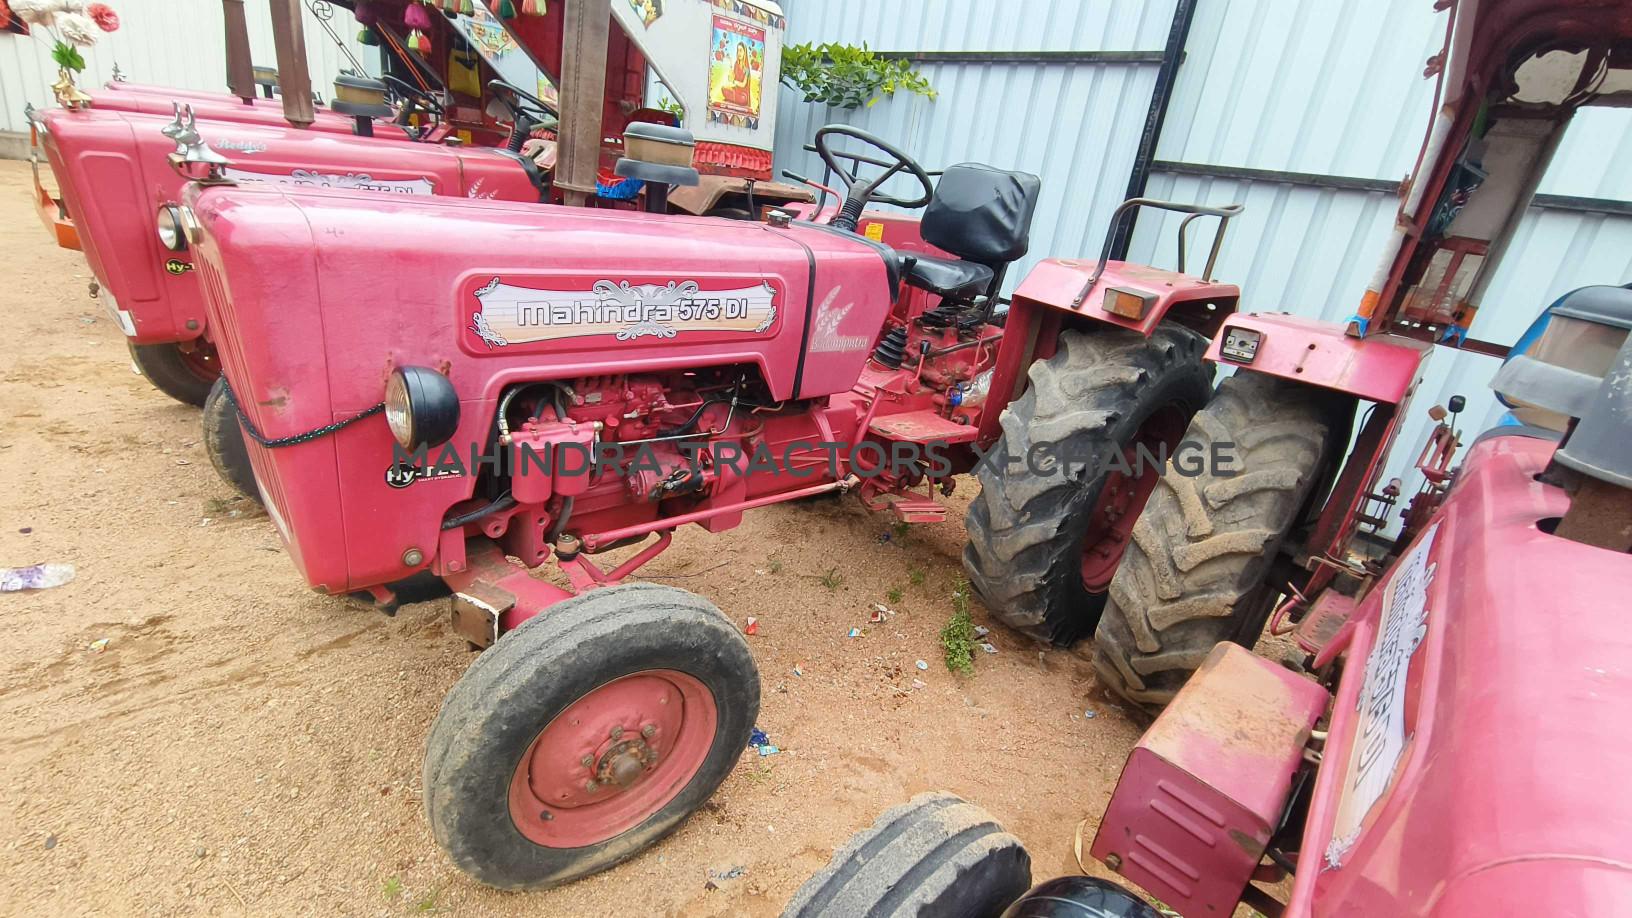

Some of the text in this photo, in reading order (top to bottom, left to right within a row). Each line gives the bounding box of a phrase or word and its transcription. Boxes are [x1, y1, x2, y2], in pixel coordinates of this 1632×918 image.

[516, 297, 749, 327] Mahindra 575 DI
